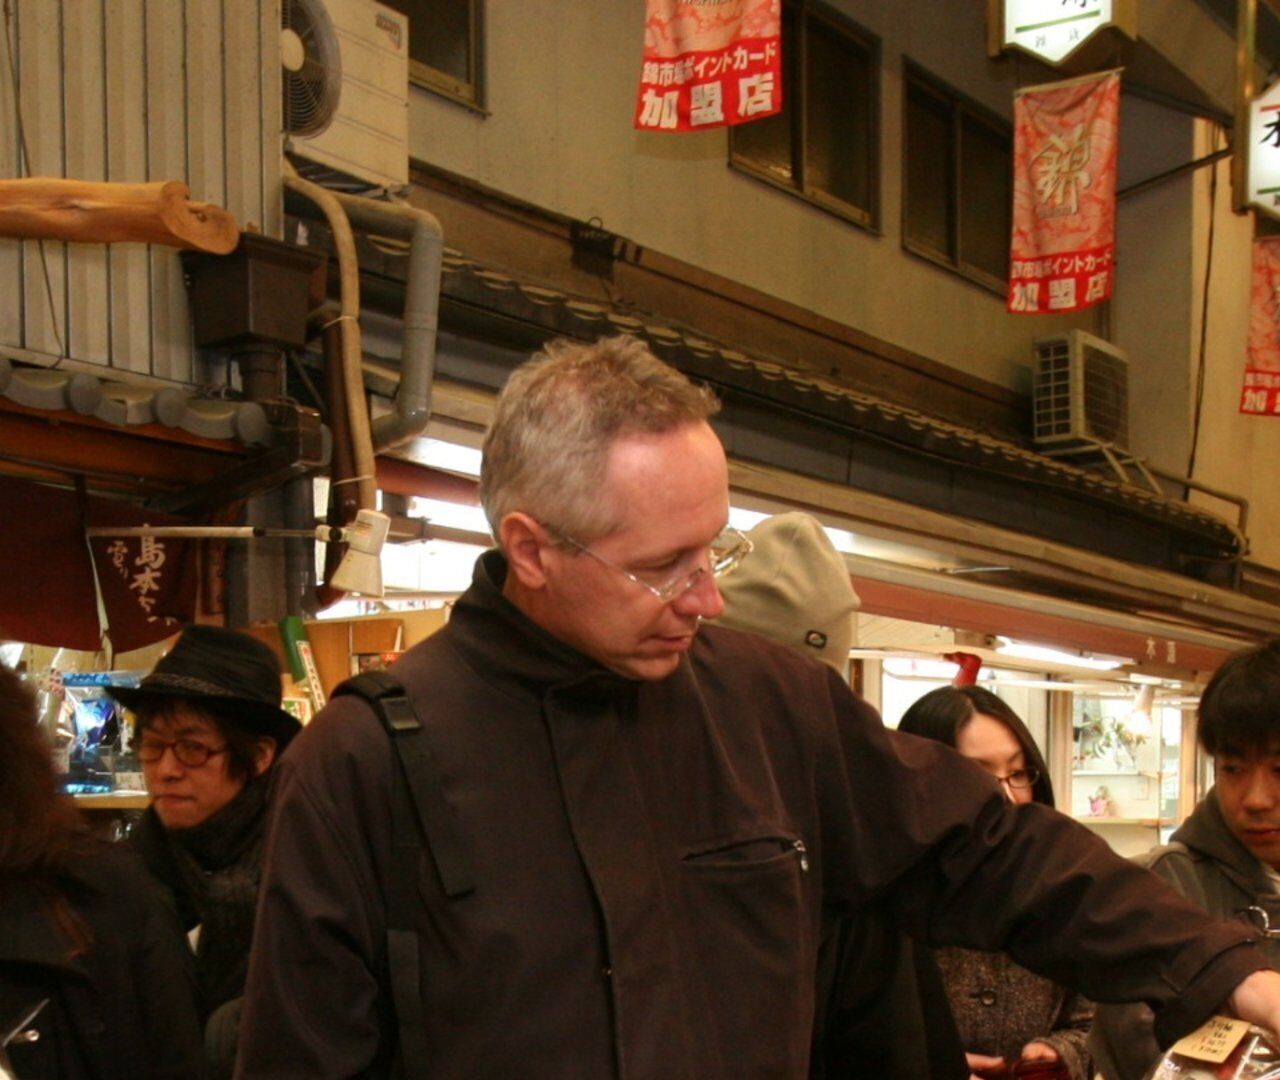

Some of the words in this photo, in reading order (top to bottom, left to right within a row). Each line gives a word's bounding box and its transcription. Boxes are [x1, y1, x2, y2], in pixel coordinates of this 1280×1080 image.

[639, 72, 775, 129] 加盟店
[1010, 271, 1109, 312] 加盟店
